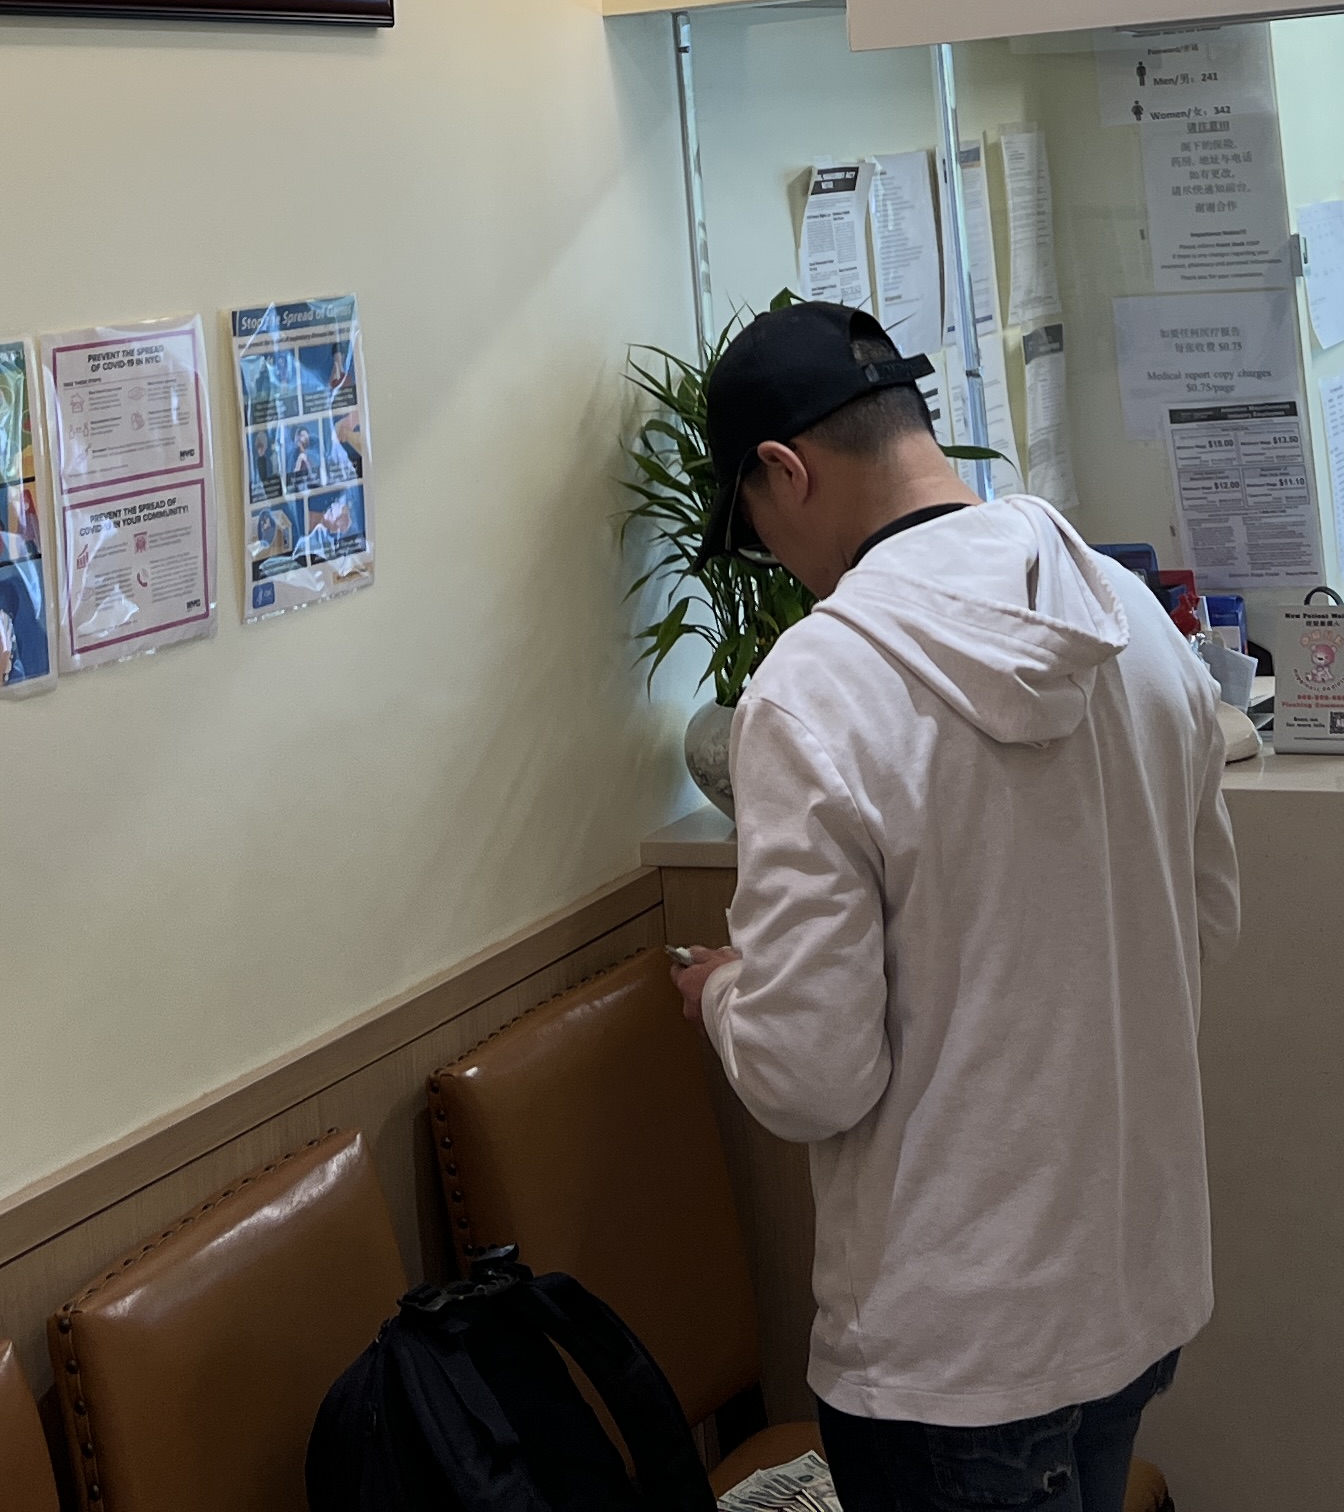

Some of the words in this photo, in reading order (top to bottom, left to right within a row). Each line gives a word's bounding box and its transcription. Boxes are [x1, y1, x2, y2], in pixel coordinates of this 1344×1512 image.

[1200, 72, 1219, 83] 241
[281, 308, 314, 327] Spread
[88, 350, 121, 363] PREVENT
[122, 348, 135, 358] THE
[137, 344, 164, 357] SPREAD
[103, 358, 134, 371] COVID-19
[1147, 370, 1182, 382] Medical
[1184, 371, 1211, 382] report
[1213, 371, 1235, 382] copy
[1237, 368, 1273, 380] charges
[1185, 382, 1236, 394] $0.75/page
[1214, 481, 1241, 490] $12.00
[1279, 477, 1306, 487] $11.10
[90, 510, 122, 524] PREVENT
[123, 505, 137, 516] THE
[138, 501, 166, 514] SPREAD
[122, 516, 142, 528] YOUR
